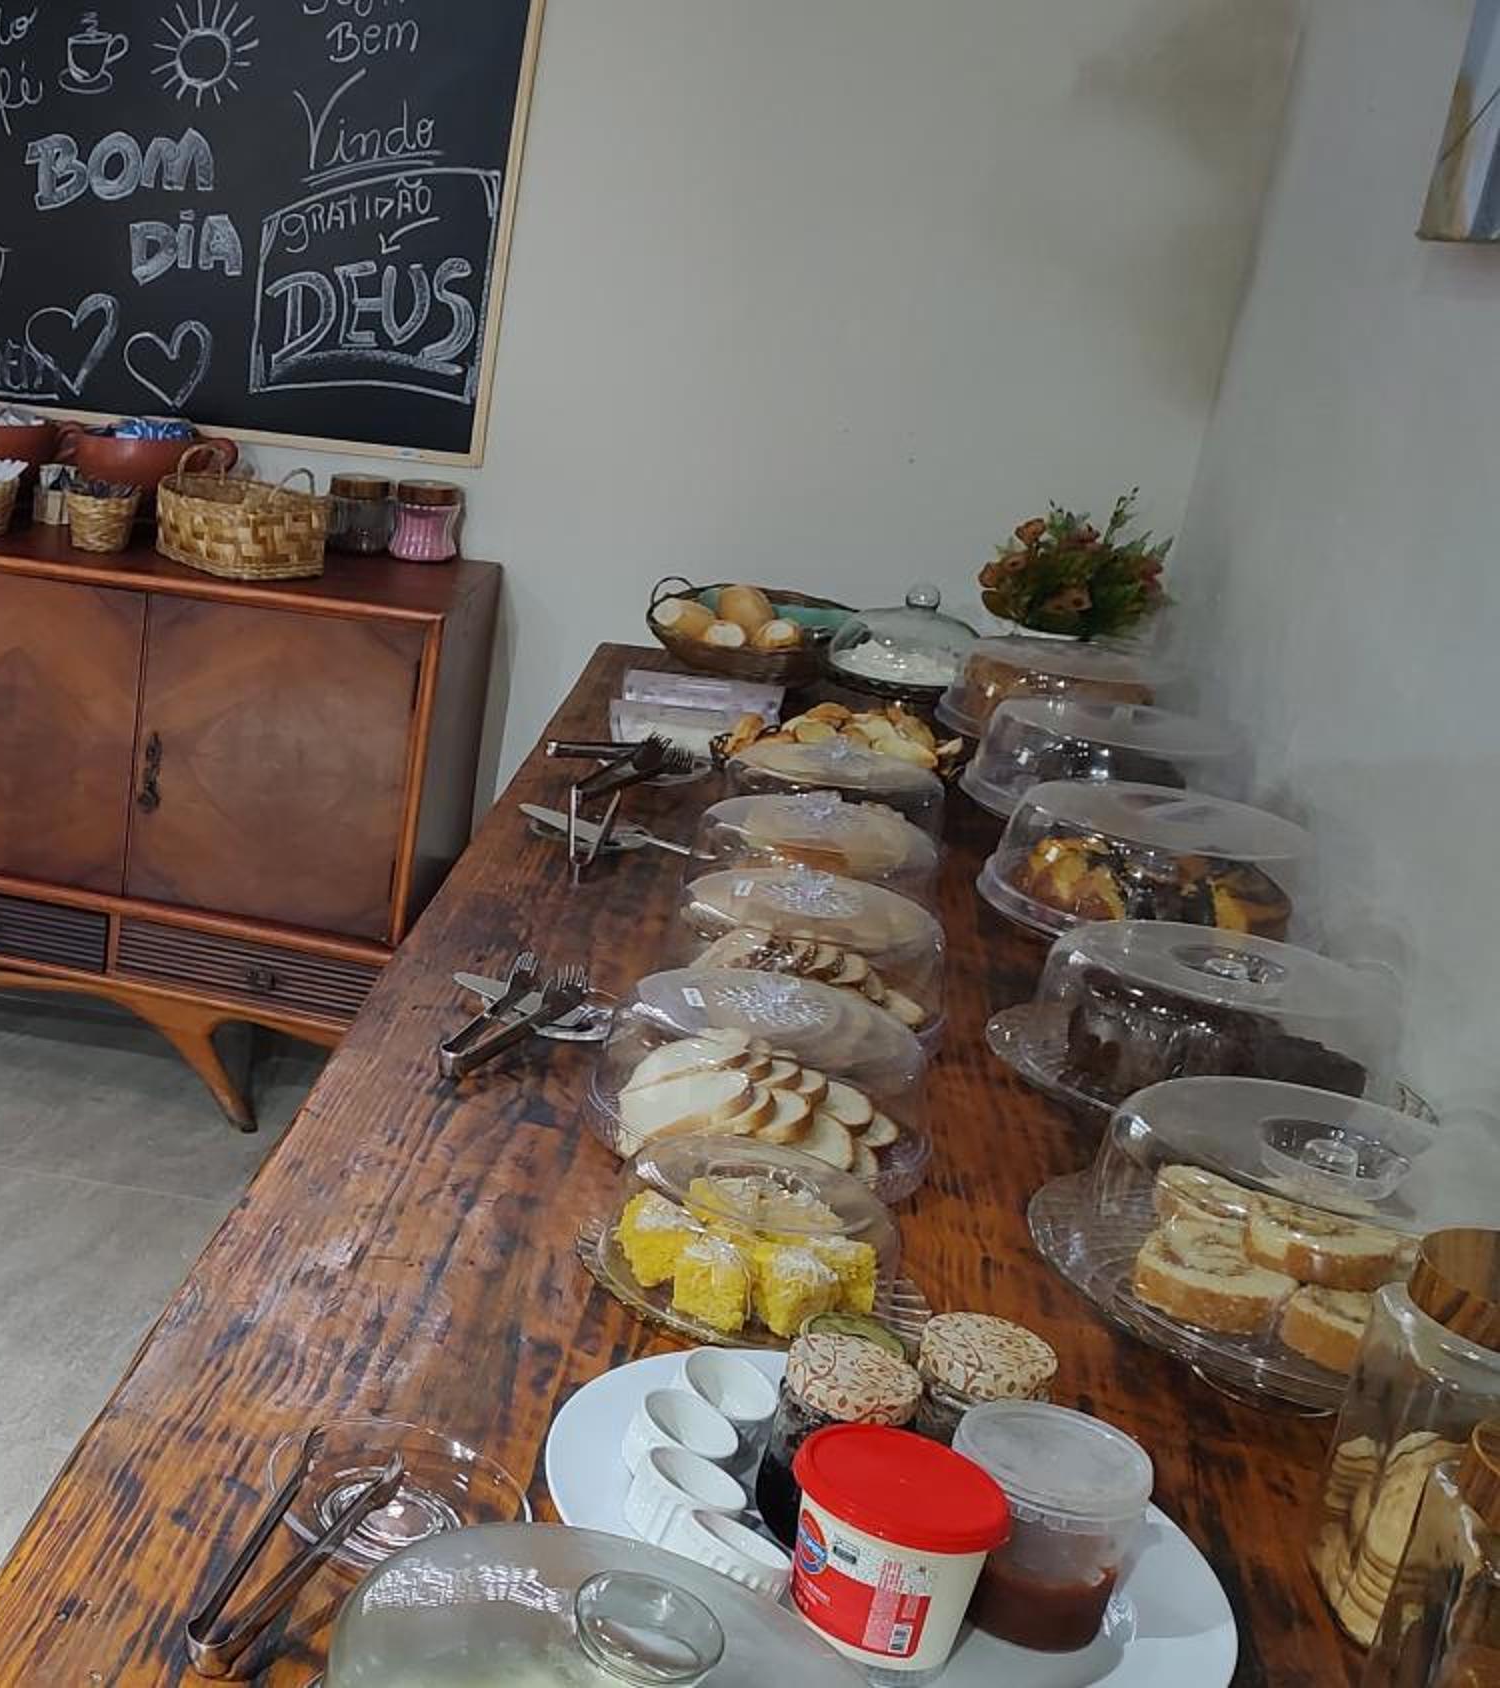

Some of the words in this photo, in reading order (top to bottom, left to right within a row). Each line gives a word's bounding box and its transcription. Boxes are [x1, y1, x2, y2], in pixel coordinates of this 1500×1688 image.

[326, 19, 419, 62] Bem
[293, 68, 435, 170] Vindo
[265, 257, 476, 367] DEUS
